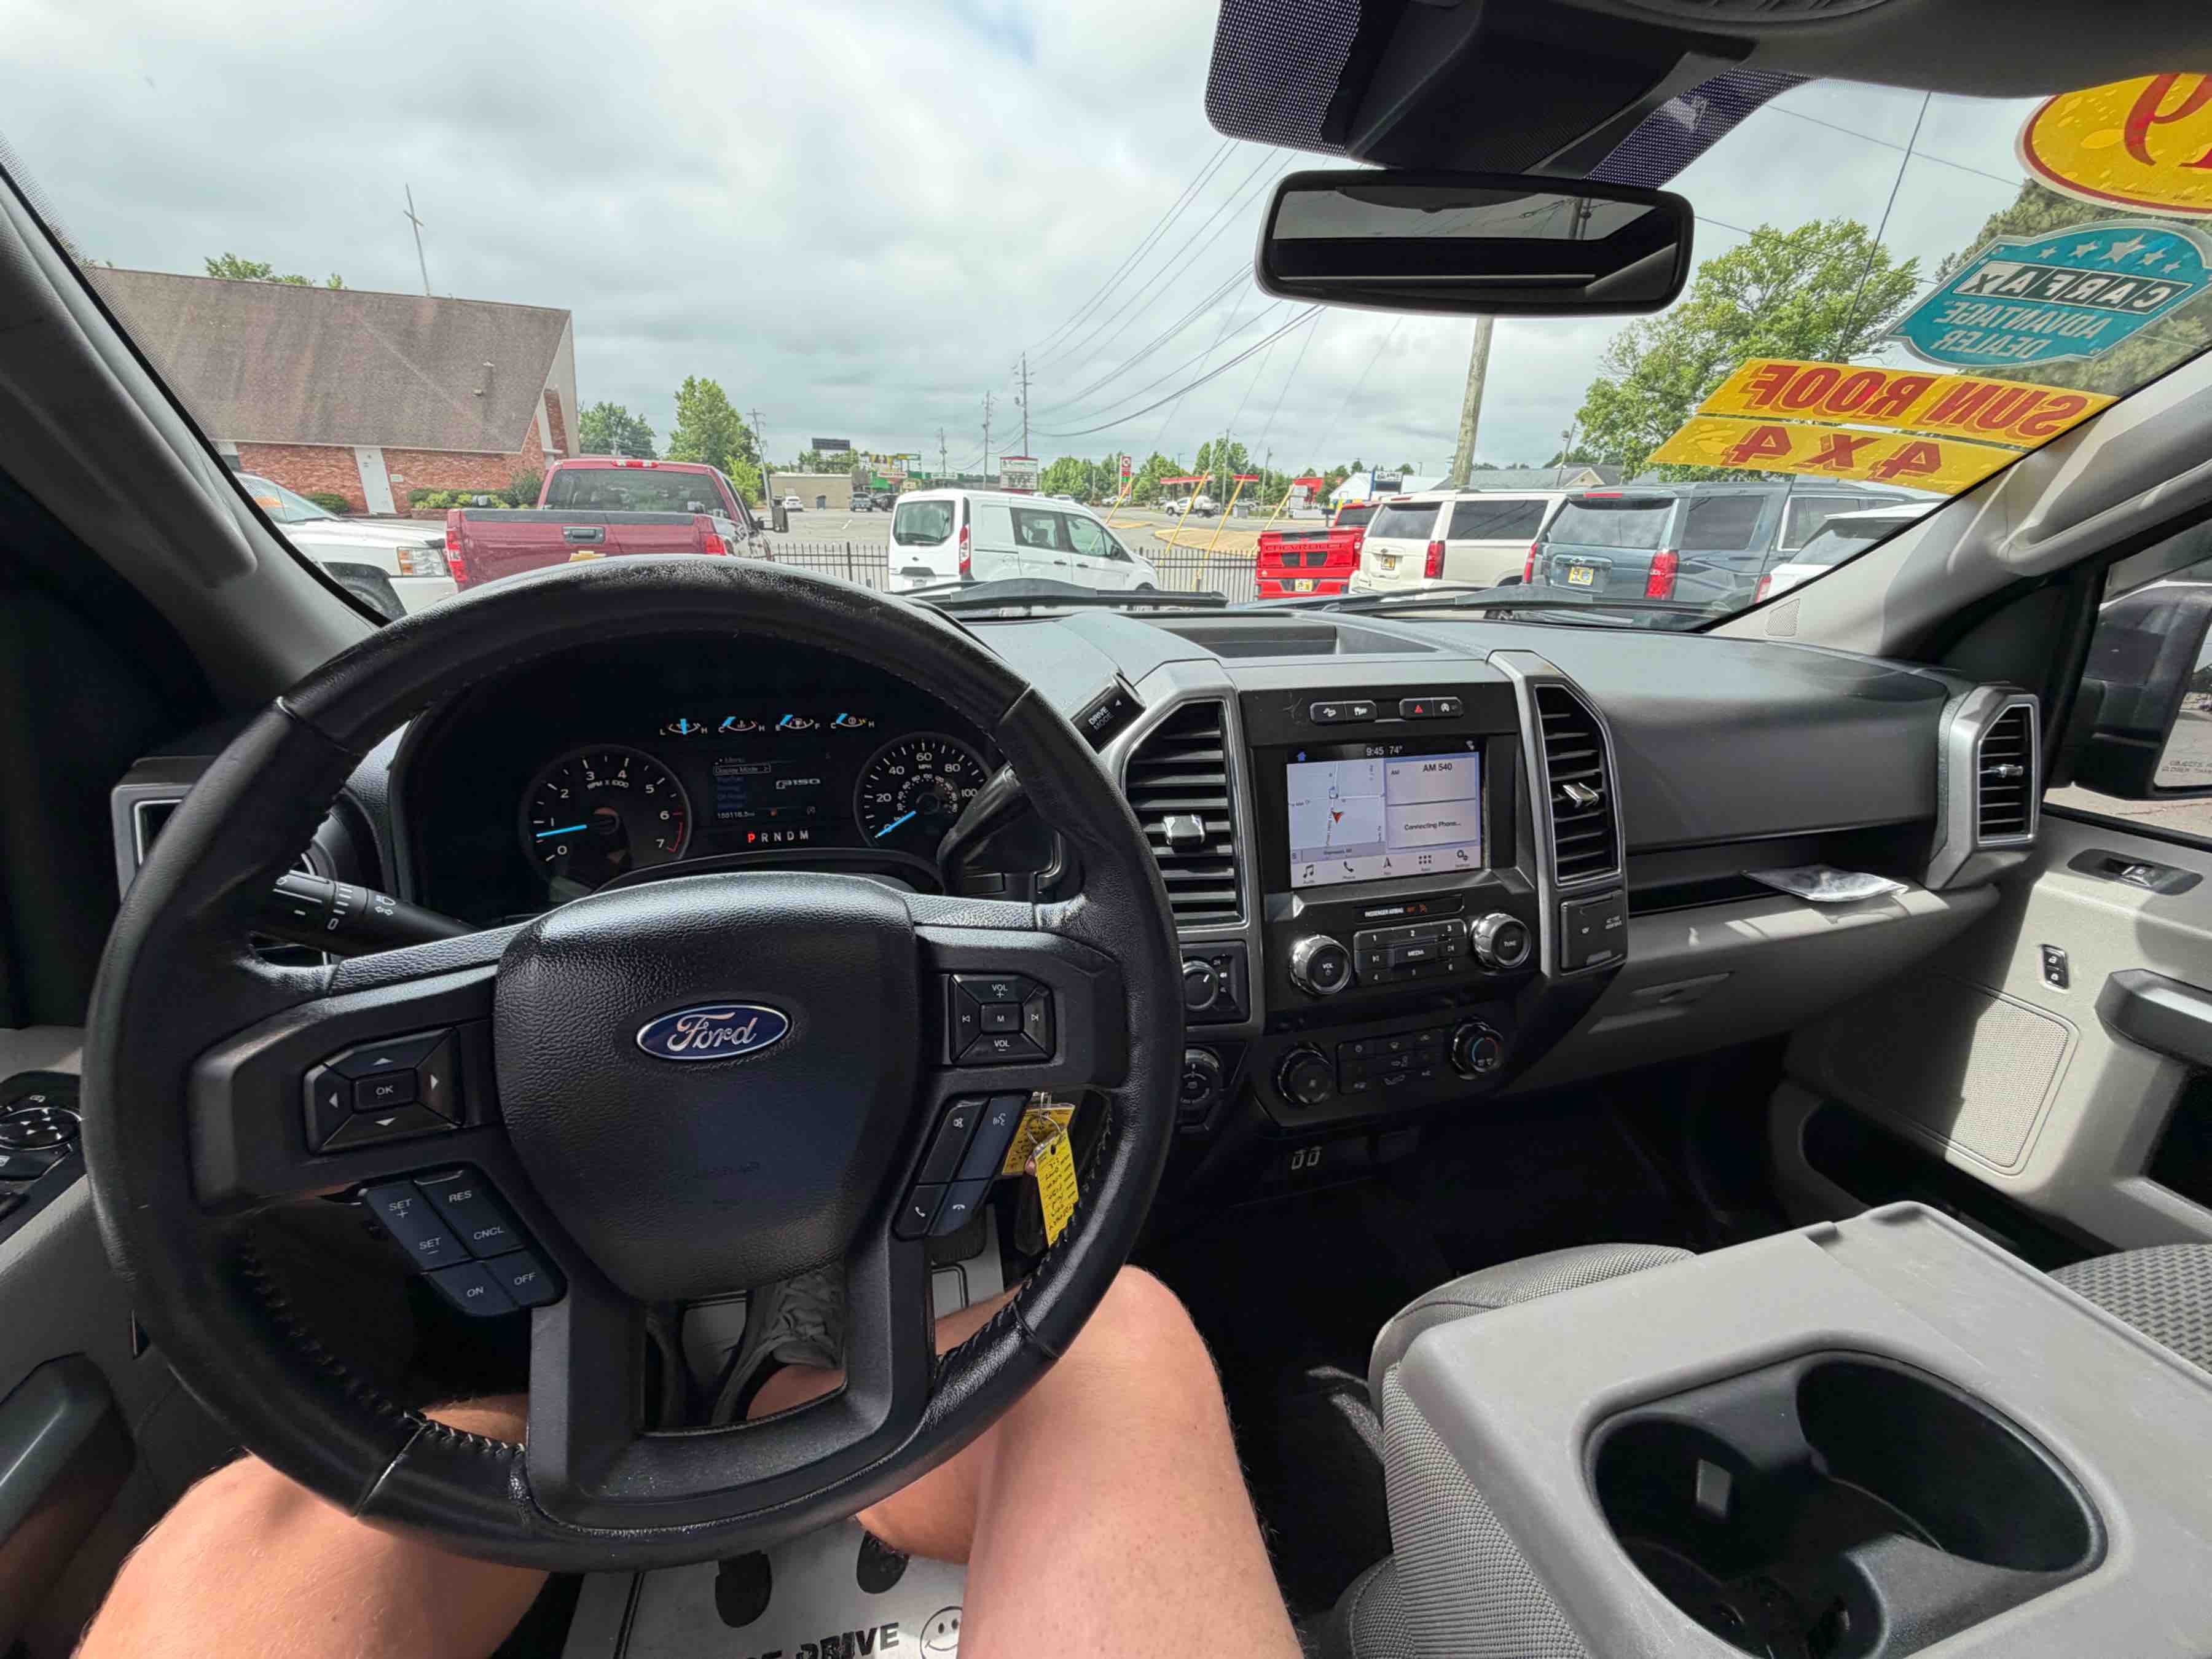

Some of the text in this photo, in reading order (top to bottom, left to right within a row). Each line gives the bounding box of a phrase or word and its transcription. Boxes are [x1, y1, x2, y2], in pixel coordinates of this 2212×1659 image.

[1266, 543, 1343, 551] CHEVROLET
[1088, 707, 1108, 725] DRIVE
[1093, 712, 1115, 731] MODE
[916, 752, 932, 761] 60
[1366, 747, 1384, 756] 9:45
[888, 766, 904, 775] 40
[944, 763, 960, 772] 80
[1438, 763, 1453, 772] 540
[586, 771, 595, 780] 3
[618, 770, 627, 779] 4
[587, 780, 603, 790] RPM
[611, 779, 629, 788] 1000
[645, 784, 654, 794] 5
[560, 788, 570, 799] 2
[876, 793, 892, 802] 20
[961, 788, 979, 797] 100
[660, 810, 670, 820] 6
[1405, 822, 1437, 831] Connecting
[656, 839, 664, 849] 7
[557, 845, 567, 855] 0
[667, 1011, 759, 1051] Ford
[375, 1085, 394, 1096] OK
[449, 1190, 473, 1202] RES
[388, 1198, 412, 1212] SET
[474, 1226, 504, 1241] CNCL
[419, 1237, 442, 1250] SET
[514, 1272, 536, 1285] OFF
[466, 1286, 484, 1298] ON
